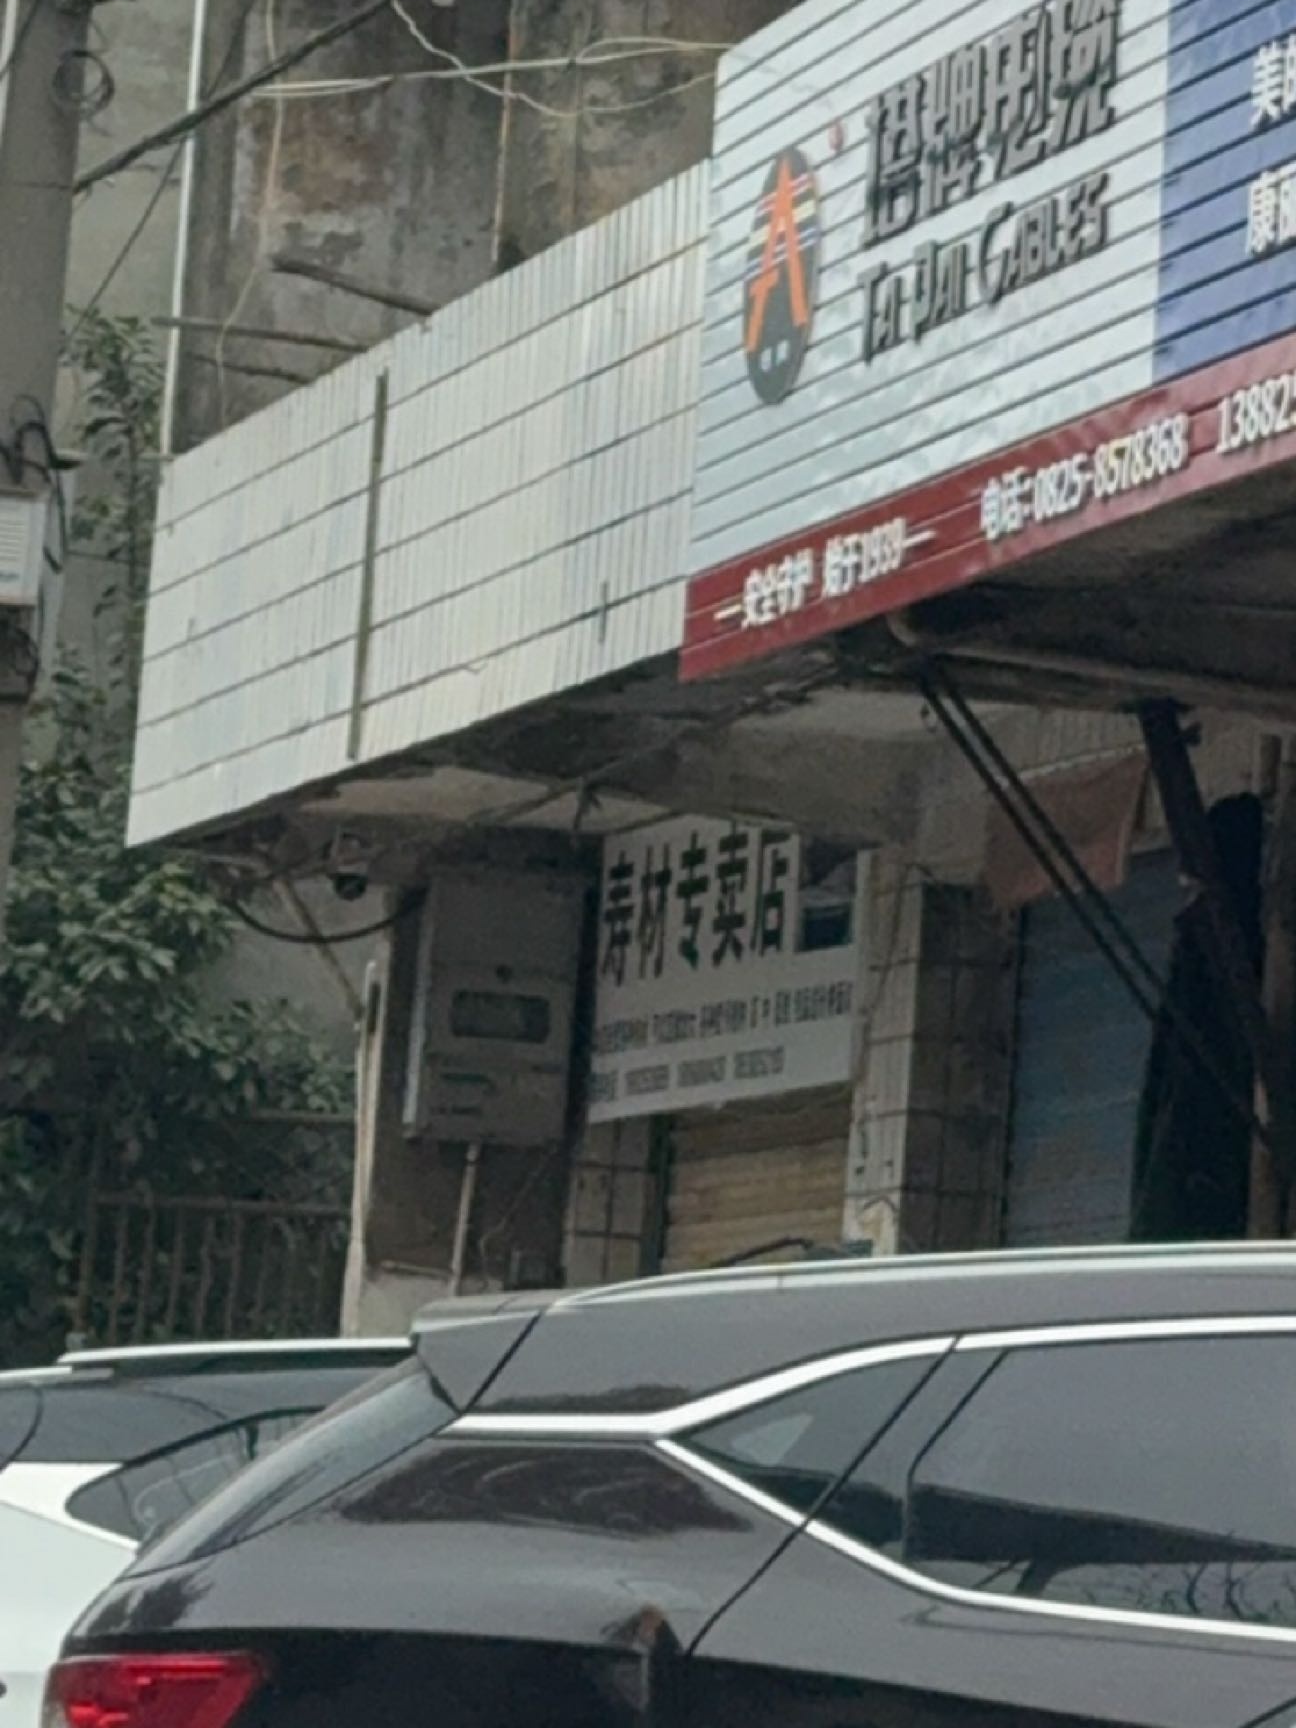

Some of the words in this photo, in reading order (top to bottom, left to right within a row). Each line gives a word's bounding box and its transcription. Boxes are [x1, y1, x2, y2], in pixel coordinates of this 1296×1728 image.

[602, 819, 791, 987] 寿材专卖店
